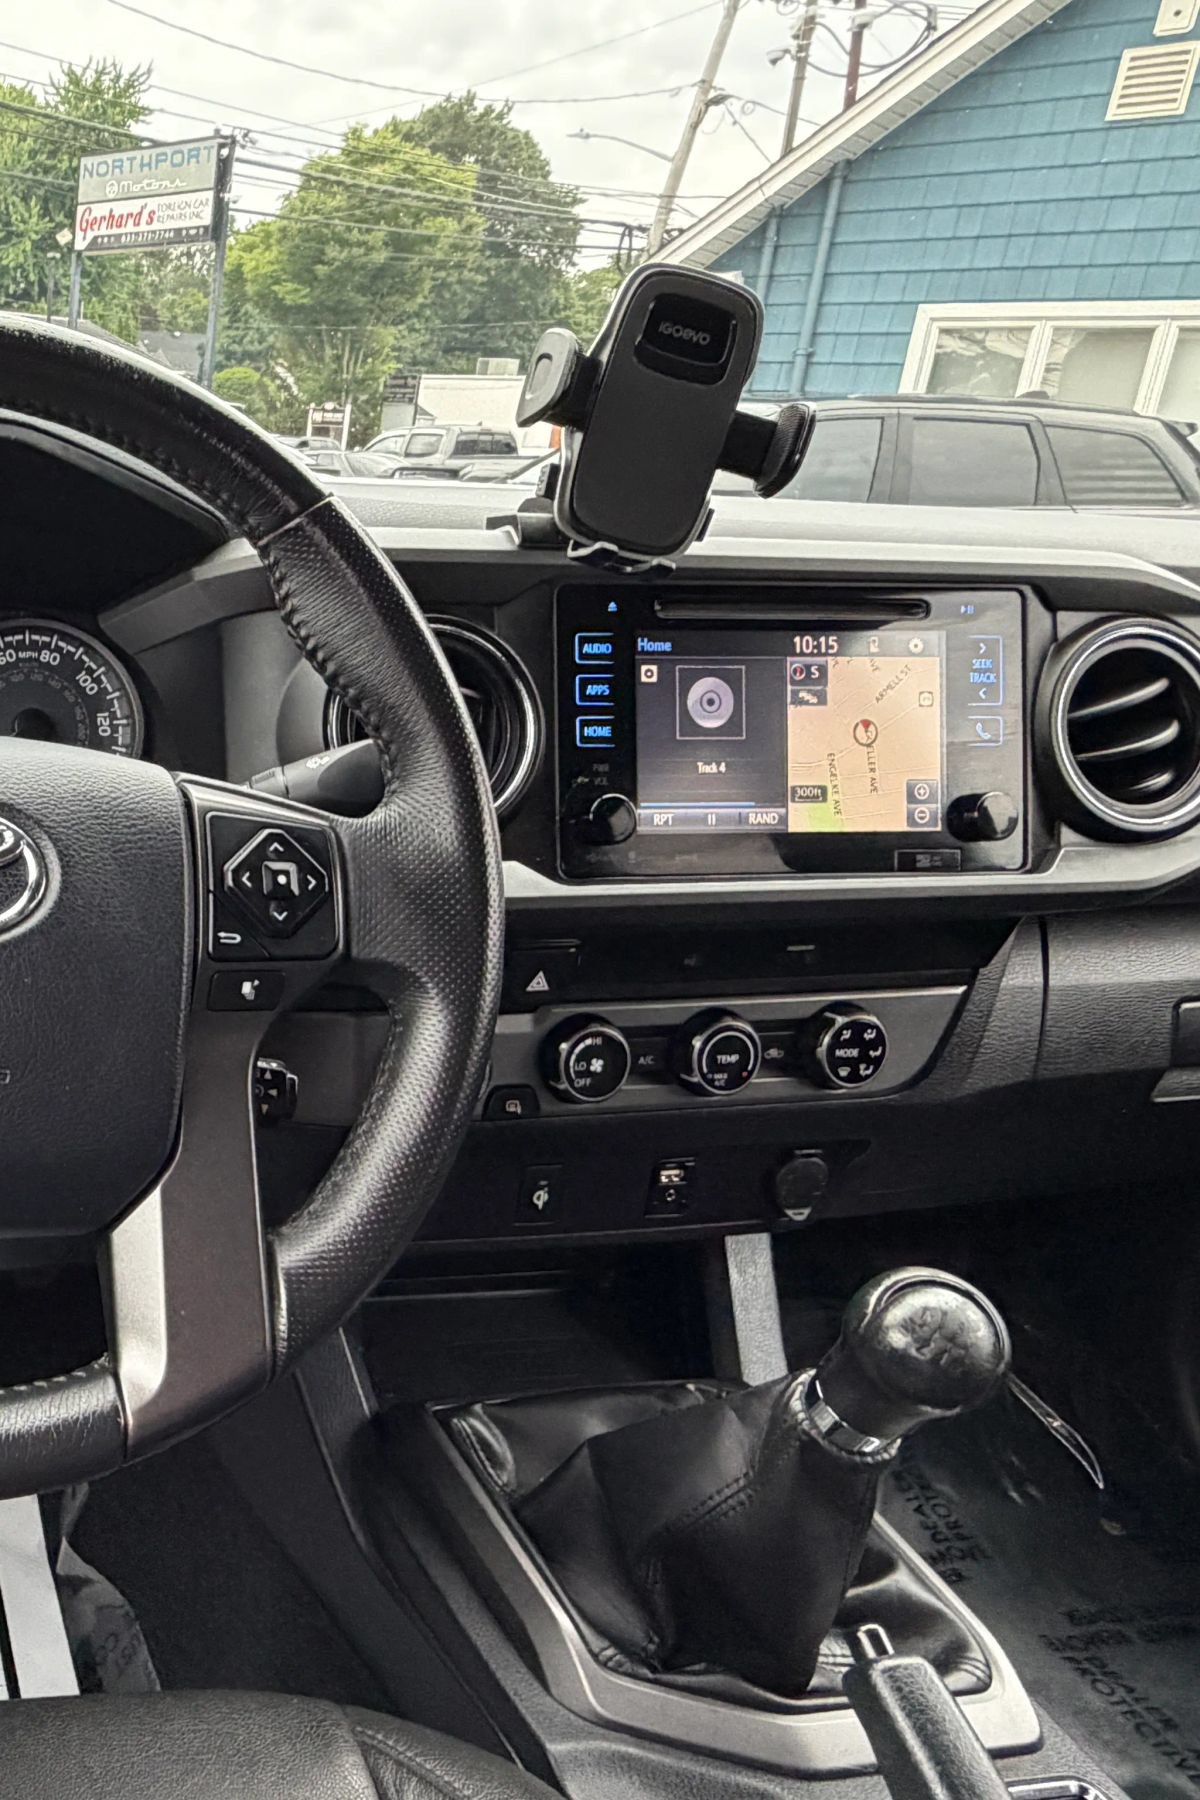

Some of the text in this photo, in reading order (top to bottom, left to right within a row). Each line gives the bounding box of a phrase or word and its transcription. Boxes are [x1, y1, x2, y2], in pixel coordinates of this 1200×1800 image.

[82, 145, 214, 179] NORTHPORT
[79, 203, 156, 241] Gerhard's
[582, 643, 612, 655] AUDIO
[637, 637, 673, 652] Home
[793, 635, 839, 654] 10:15
[18, 651, 39, 659] MPH
[39, 649, 61, 666] 80
[971, 659, 993, 669] SEEK
[810, 665, 820, 678] S
[969, 672, 997, 683] TRACK
[75, 671, 99, 696] 100
[586, 684, 610, 696] APPS
[96, 712, 112, 737] 120
[583, 726, 613, 737] HOME
[696, 761, 726, 773] Track 4
[794, 786, 822, 798] 300ft
[653, 813, 675, 826] RPT
[749, 813, 779, 825] RAND
[835, 1047, 860, 1058] MODE
[638, 1055, 655, 1065] A/C
[716, 1054, 740, 1065] TEMP
[575, 1062, 587, 1072] LO
[573, 1078, 592, 1088] OFF
